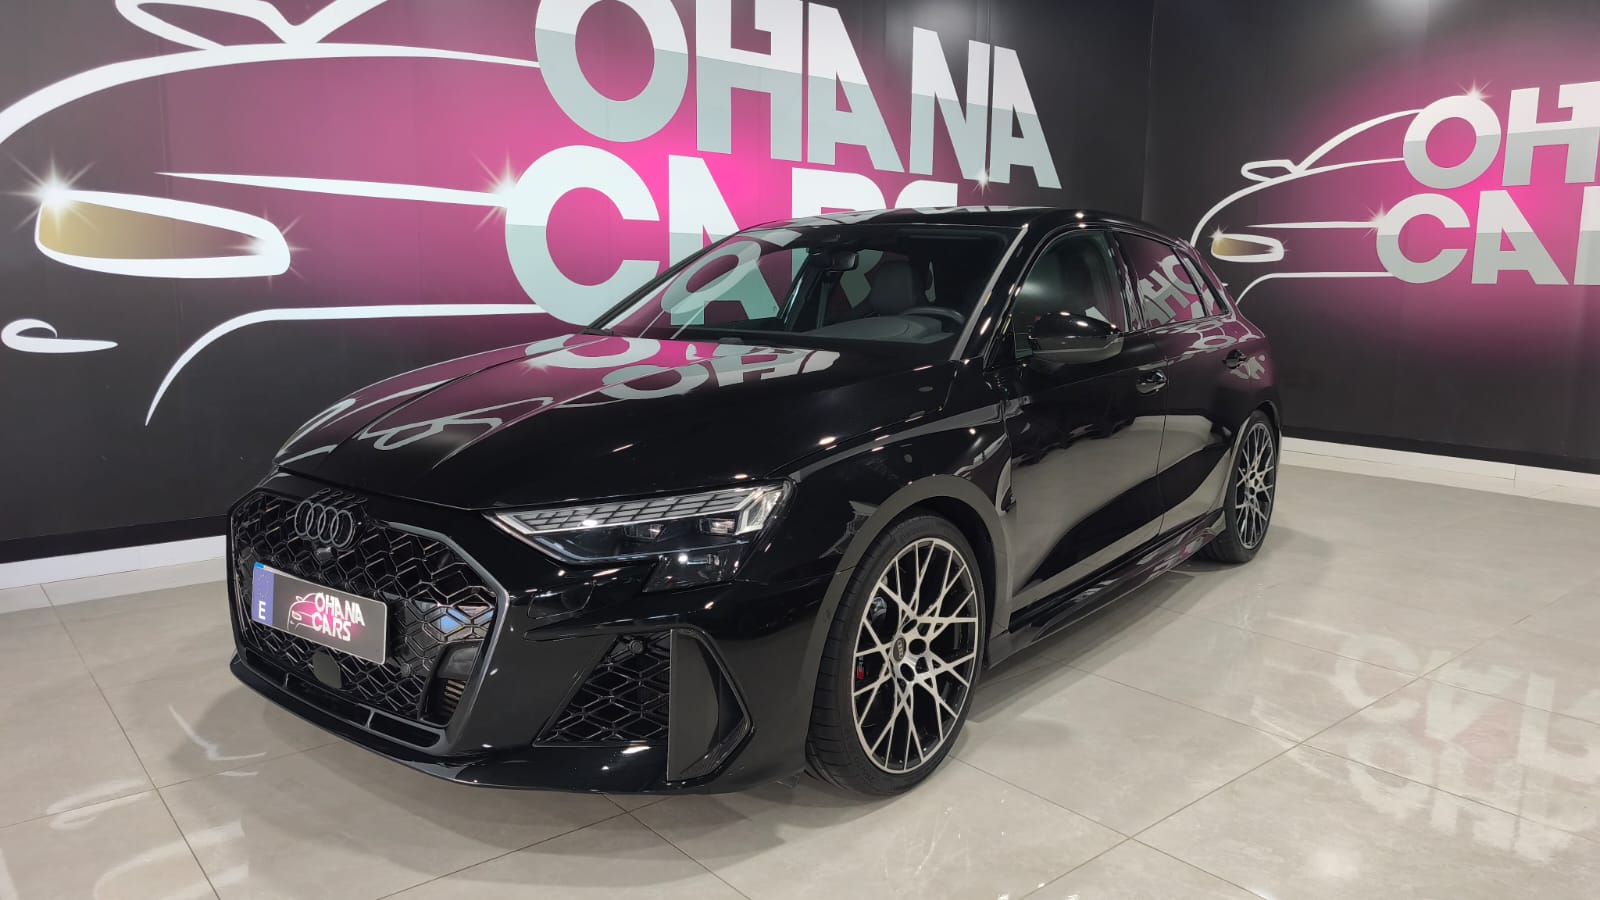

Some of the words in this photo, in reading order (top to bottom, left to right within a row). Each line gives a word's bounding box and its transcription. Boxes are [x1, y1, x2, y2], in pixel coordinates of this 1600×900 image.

[535, 0, 1062, 189] OHANA
[505, 145, 958, 327] CAR
[258, 600, 266, 621] E
[312, 611, 352, 642] CARS
[315, 592, 366, 627] OHANA
